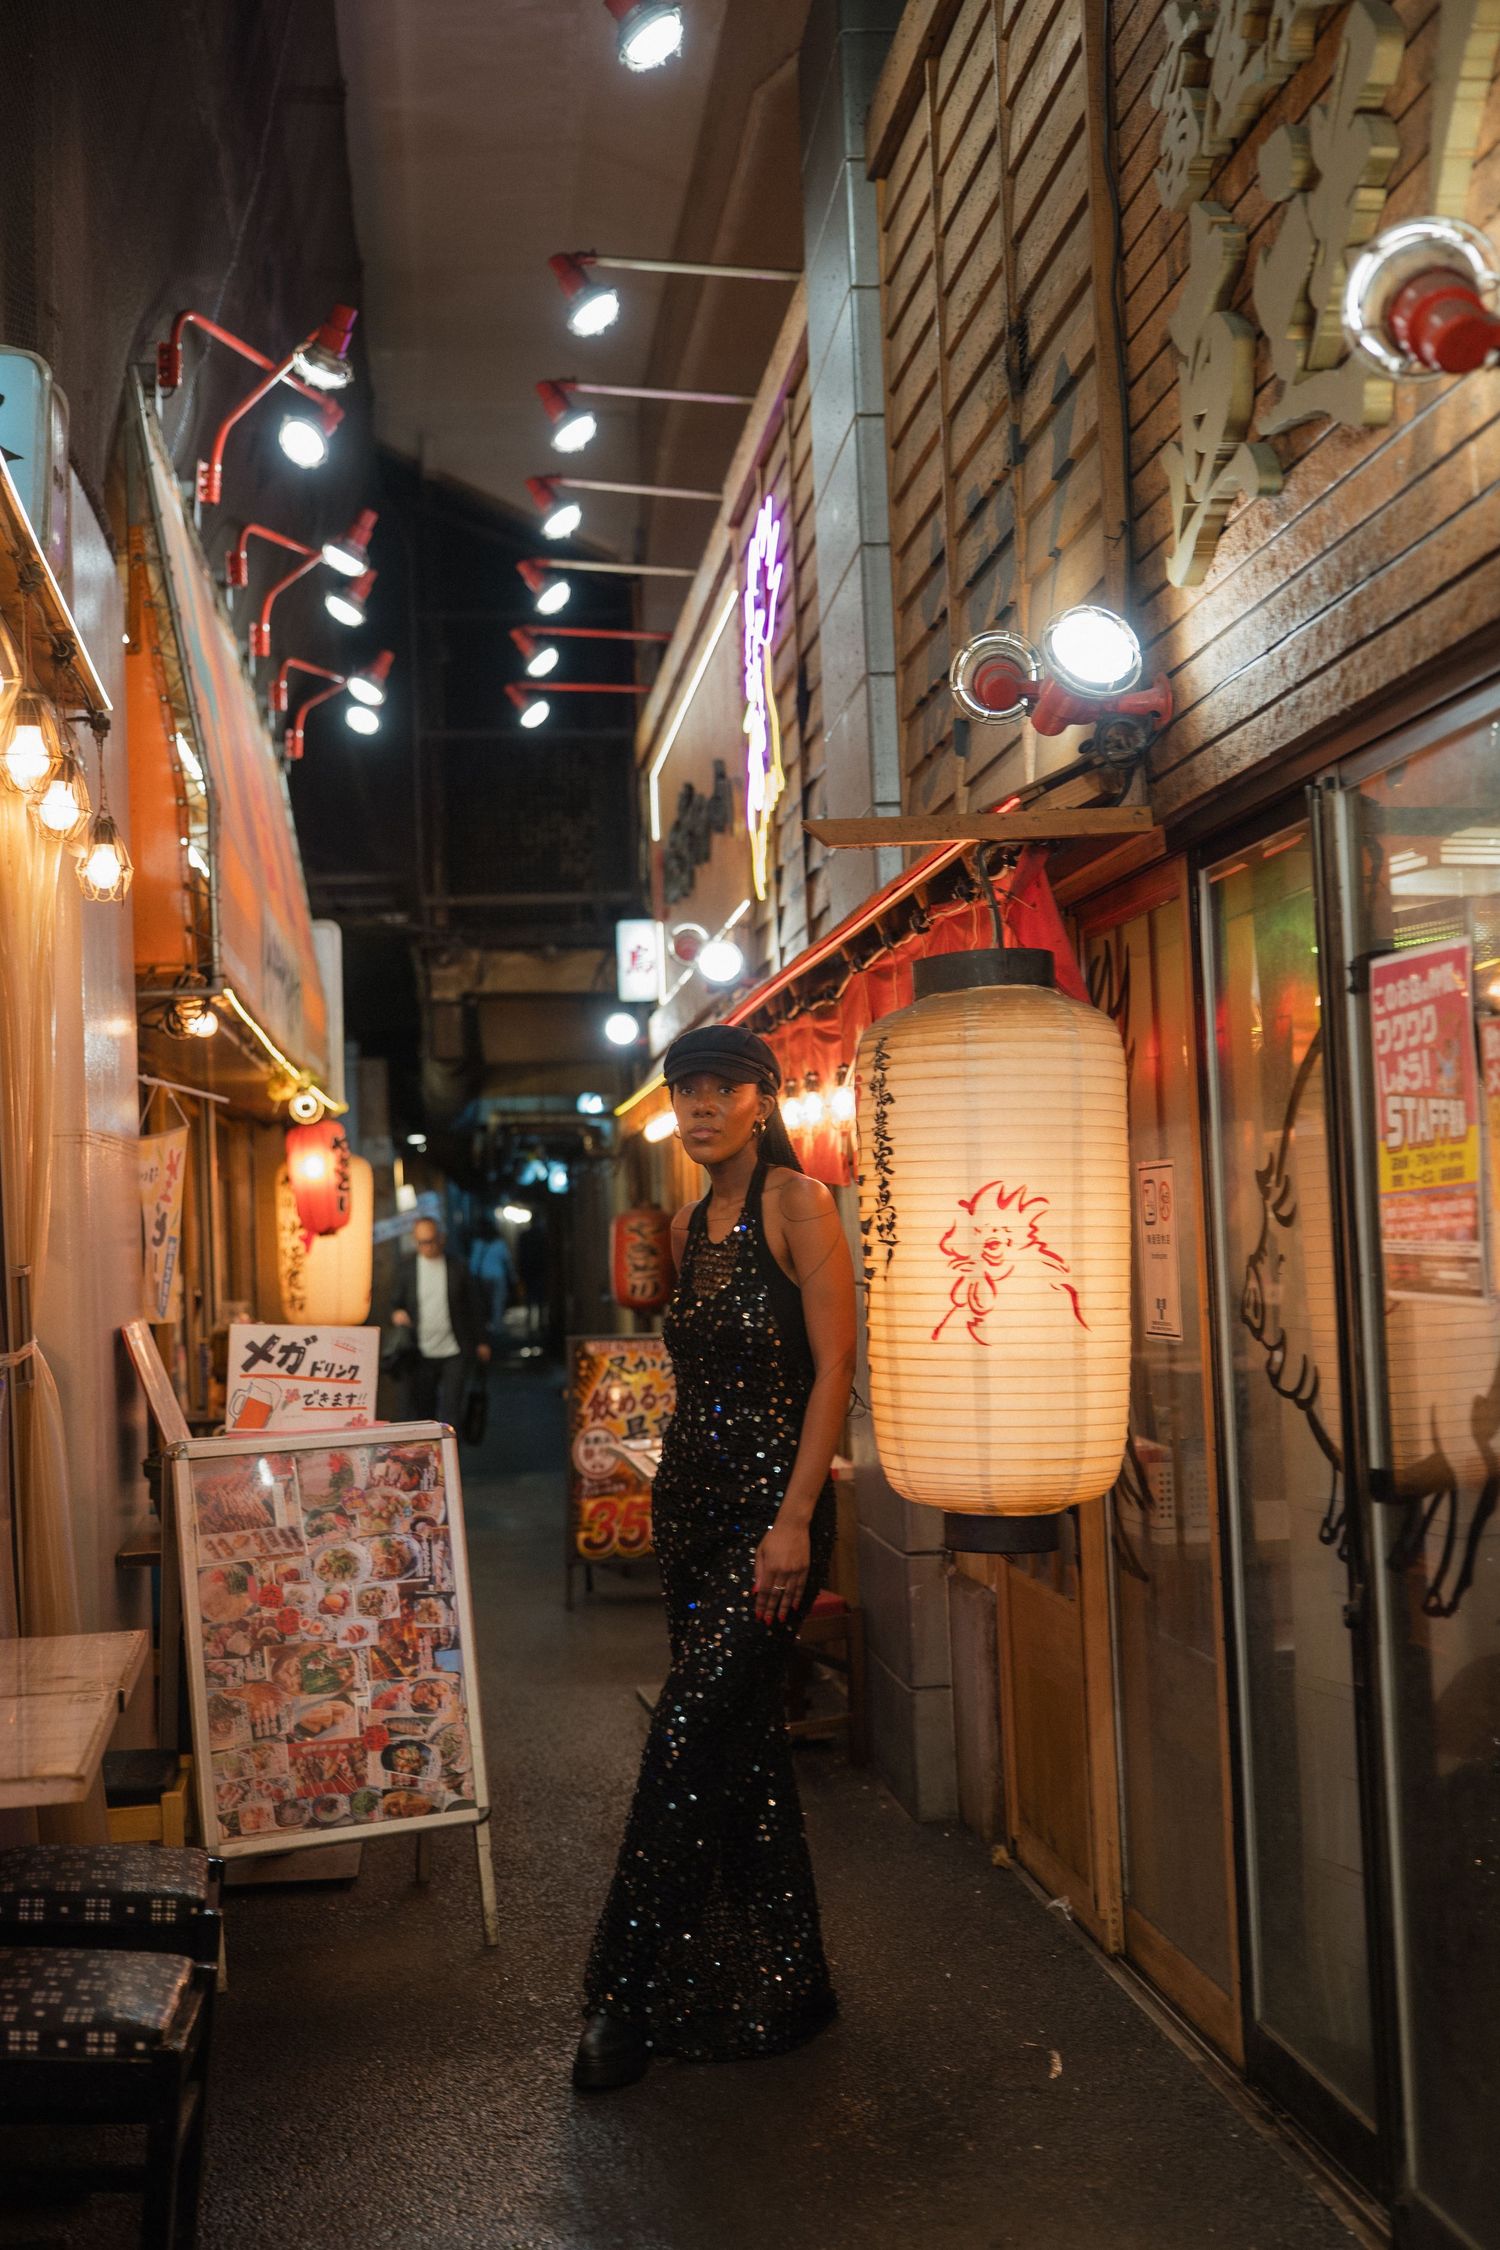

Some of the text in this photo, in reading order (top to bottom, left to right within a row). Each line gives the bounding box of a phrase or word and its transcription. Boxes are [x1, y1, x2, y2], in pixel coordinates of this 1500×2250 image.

[1375, 1004, 1438, 1055] ワクワク
[241, 1333, 318, 1375] メガ
[309, 1360, 360, 1381] ドリンク
